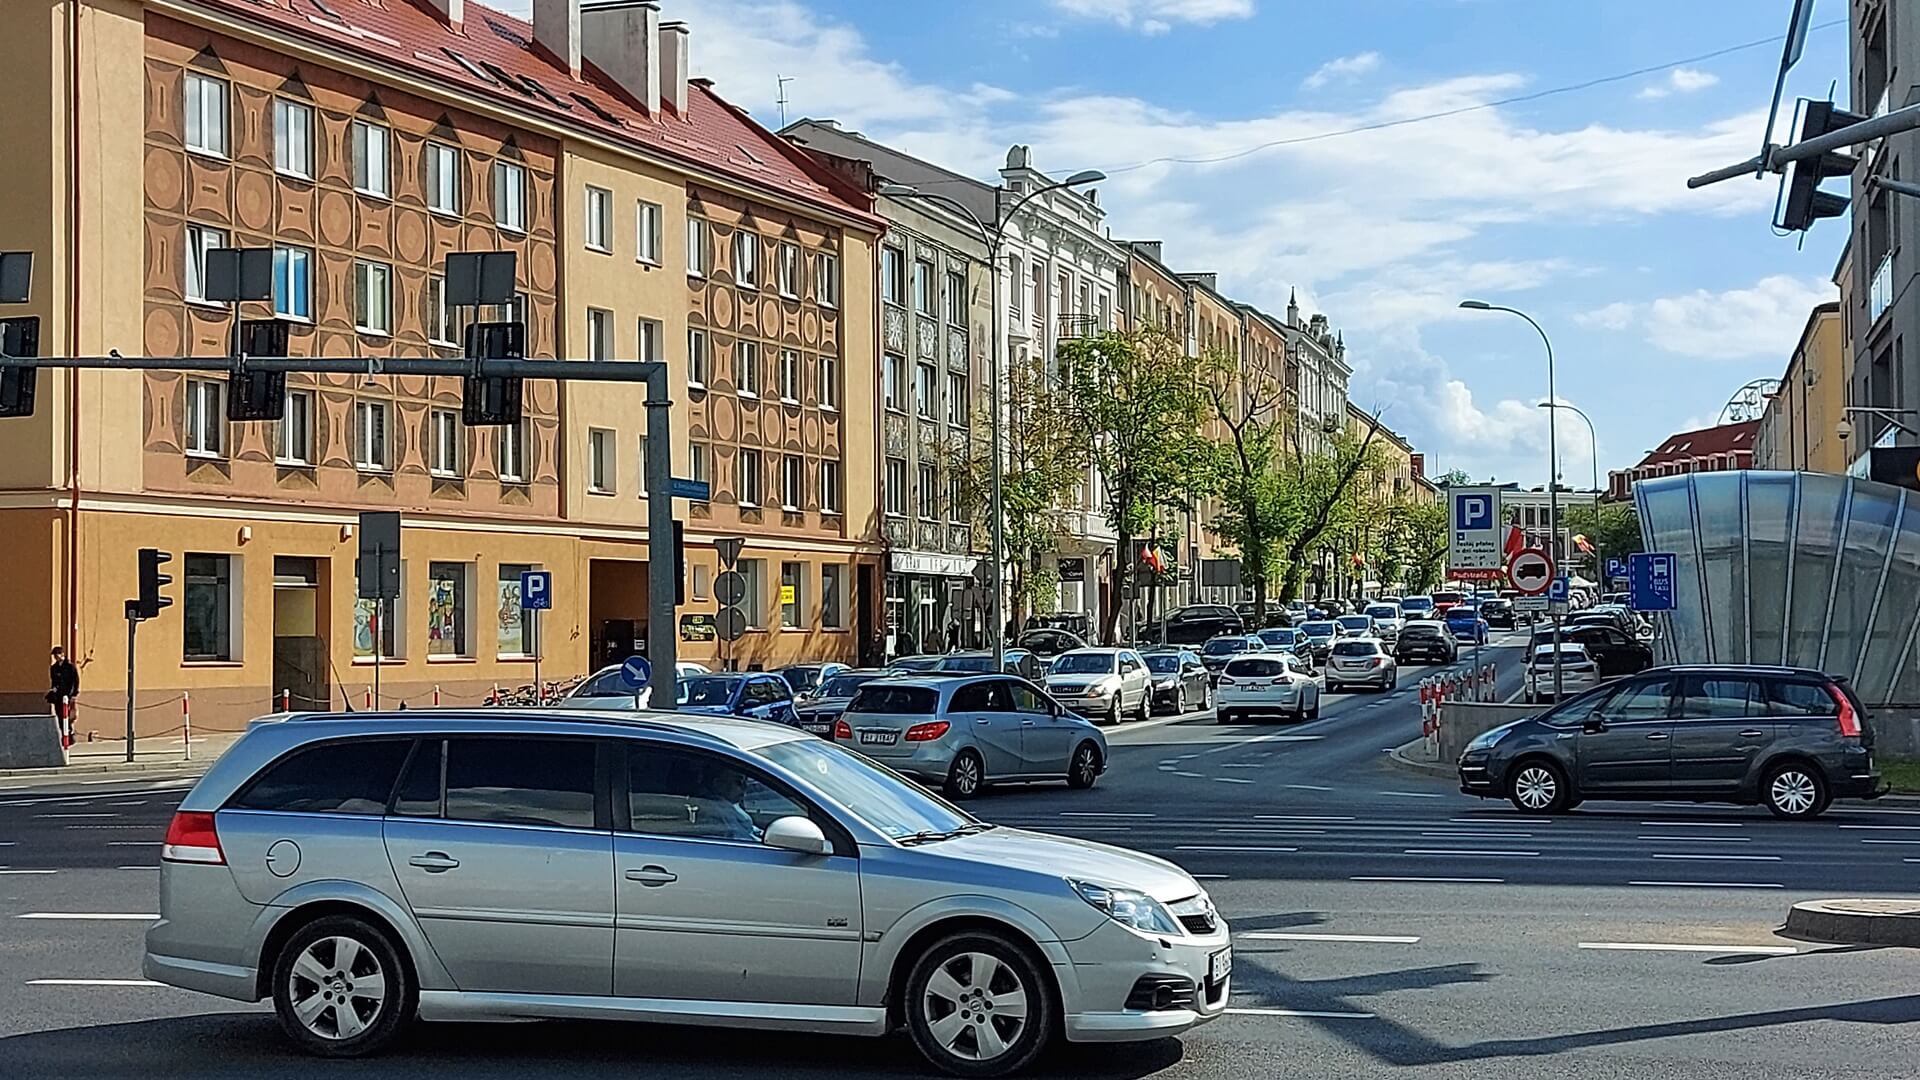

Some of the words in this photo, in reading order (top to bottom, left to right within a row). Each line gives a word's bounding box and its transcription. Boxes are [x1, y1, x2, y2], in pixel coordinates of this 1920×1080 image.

[1465, 499, 1485, 525] P
[1610, 560, 1618, 571] P
[528, 575, 544, 598] P
[1550, 580, 1563, 598] P
